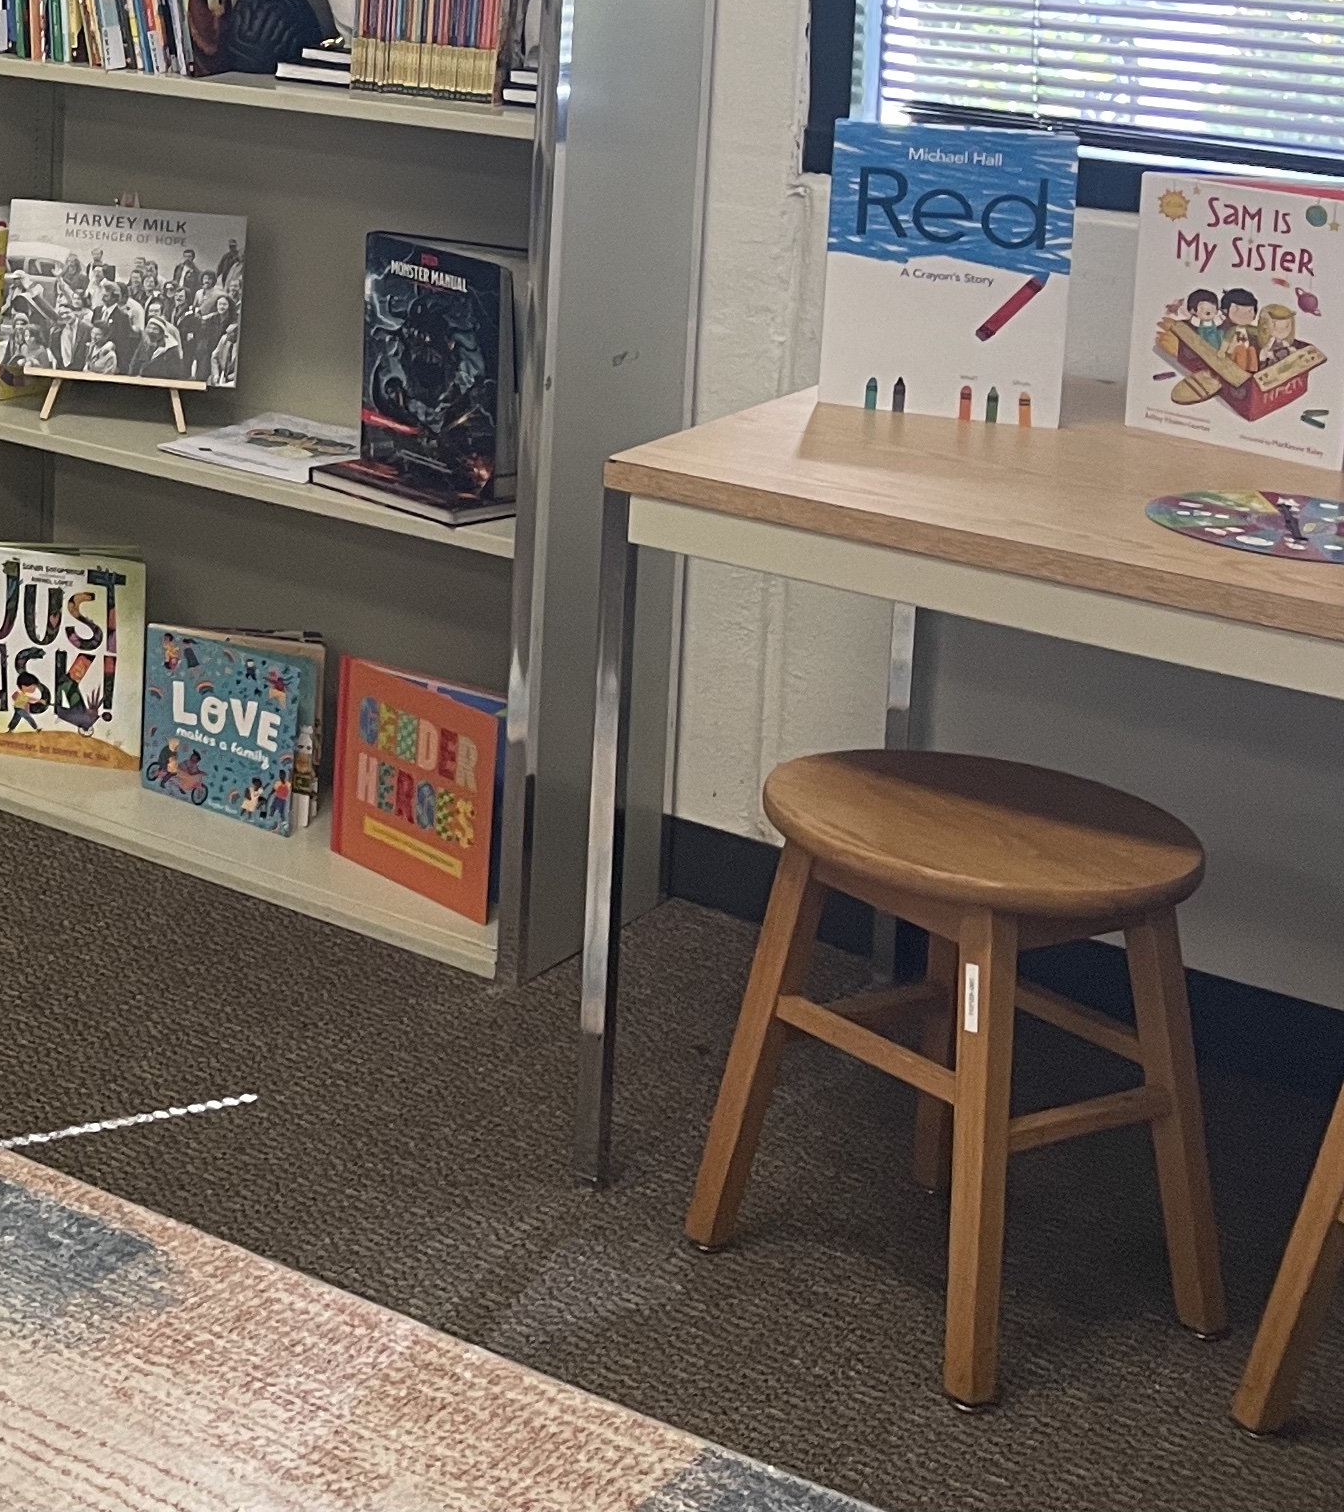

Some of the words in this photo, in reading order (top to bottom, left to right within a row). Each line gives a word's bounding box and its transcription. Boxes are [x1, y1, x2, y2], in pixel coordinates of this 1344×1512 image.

[908, 147, 969, 165] Michael
[973, 151, 1003, 167] Hall
[64, 212, 138, 232] HARVEY
[141, 215, 188, 234] MILK
[856, 166, 1049, 251] Red
[65, 228, 134, 244] MESSENGER
[137, 234, 152, 245] OF
[154, 234, 188, 248] HOPE
[389, 260, 429, 287] MONSTER
[429, 270, 469, 293] MANUAL
[900, 267, 910, 277] A
[913, 269, 961, 286] Crayon's
[964, 273, 994, 288] Story
[172, 680, 281, 753] LOVE
[176, 726, 216, 748] makes
[219, 740, 228, 750] a
[230, 741, 270, 770] family
[359, 696, 478, 793] GENDER
[357, 751, 476, 849] HEROES
